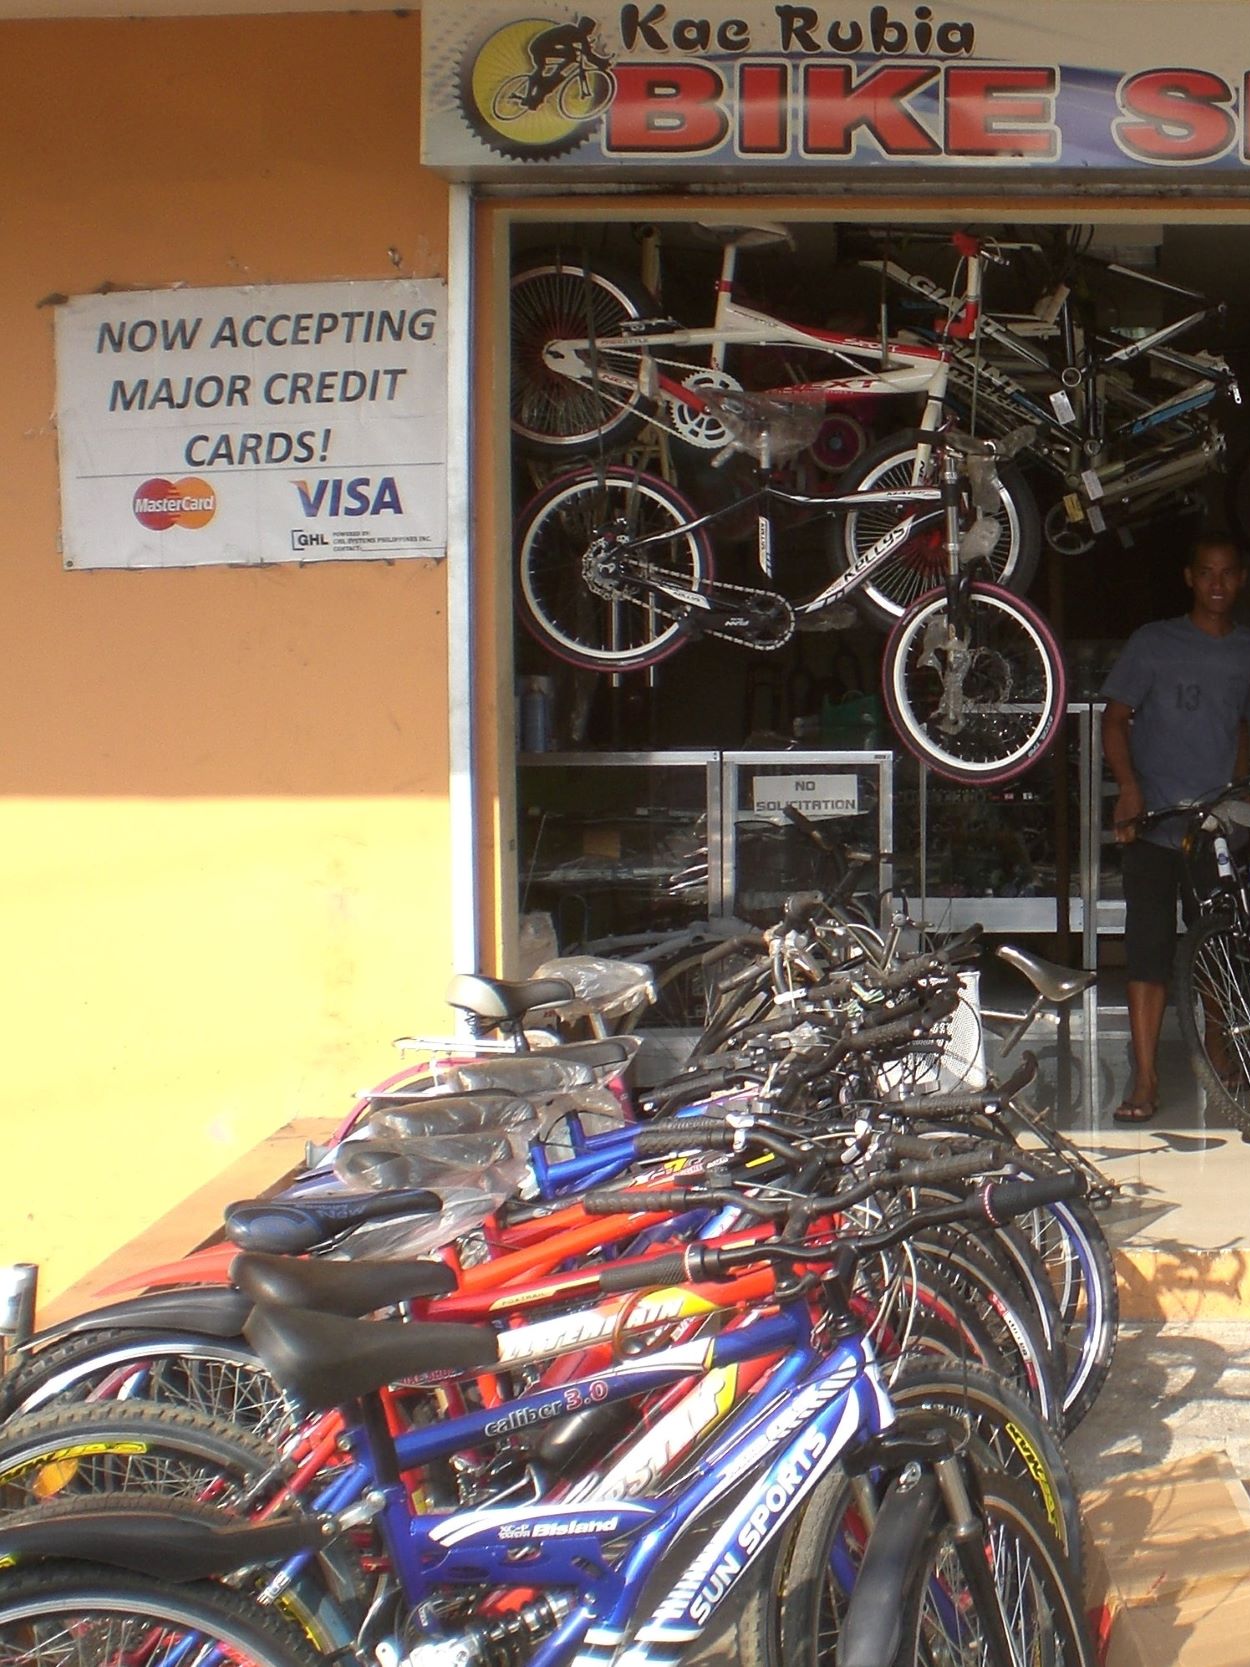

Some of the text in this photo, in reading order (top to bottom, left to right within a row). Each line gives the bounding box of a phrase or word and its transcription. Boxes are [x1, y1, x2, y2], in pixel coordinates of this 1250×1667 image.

[620, 4, 976, 57] Kae Rubia
[602, 58, 1061, 160] BIKE
[97, 308, 438, 354] NOW ACCEPTING
[109, 367, 407, 412] MAJOR CREDIT
[184, 428, 332, 467] CARDS!
[134, 494, 216, 513] MasterCard
[290, 476, 404, 518] VISA
[297, 533, 329, 546] GHL
[795, 780, 816, 791] NO
[484, 1379, 609, 1437] caliber 3.0
[689, 1425, 828, 1625] SUN SPORTS
